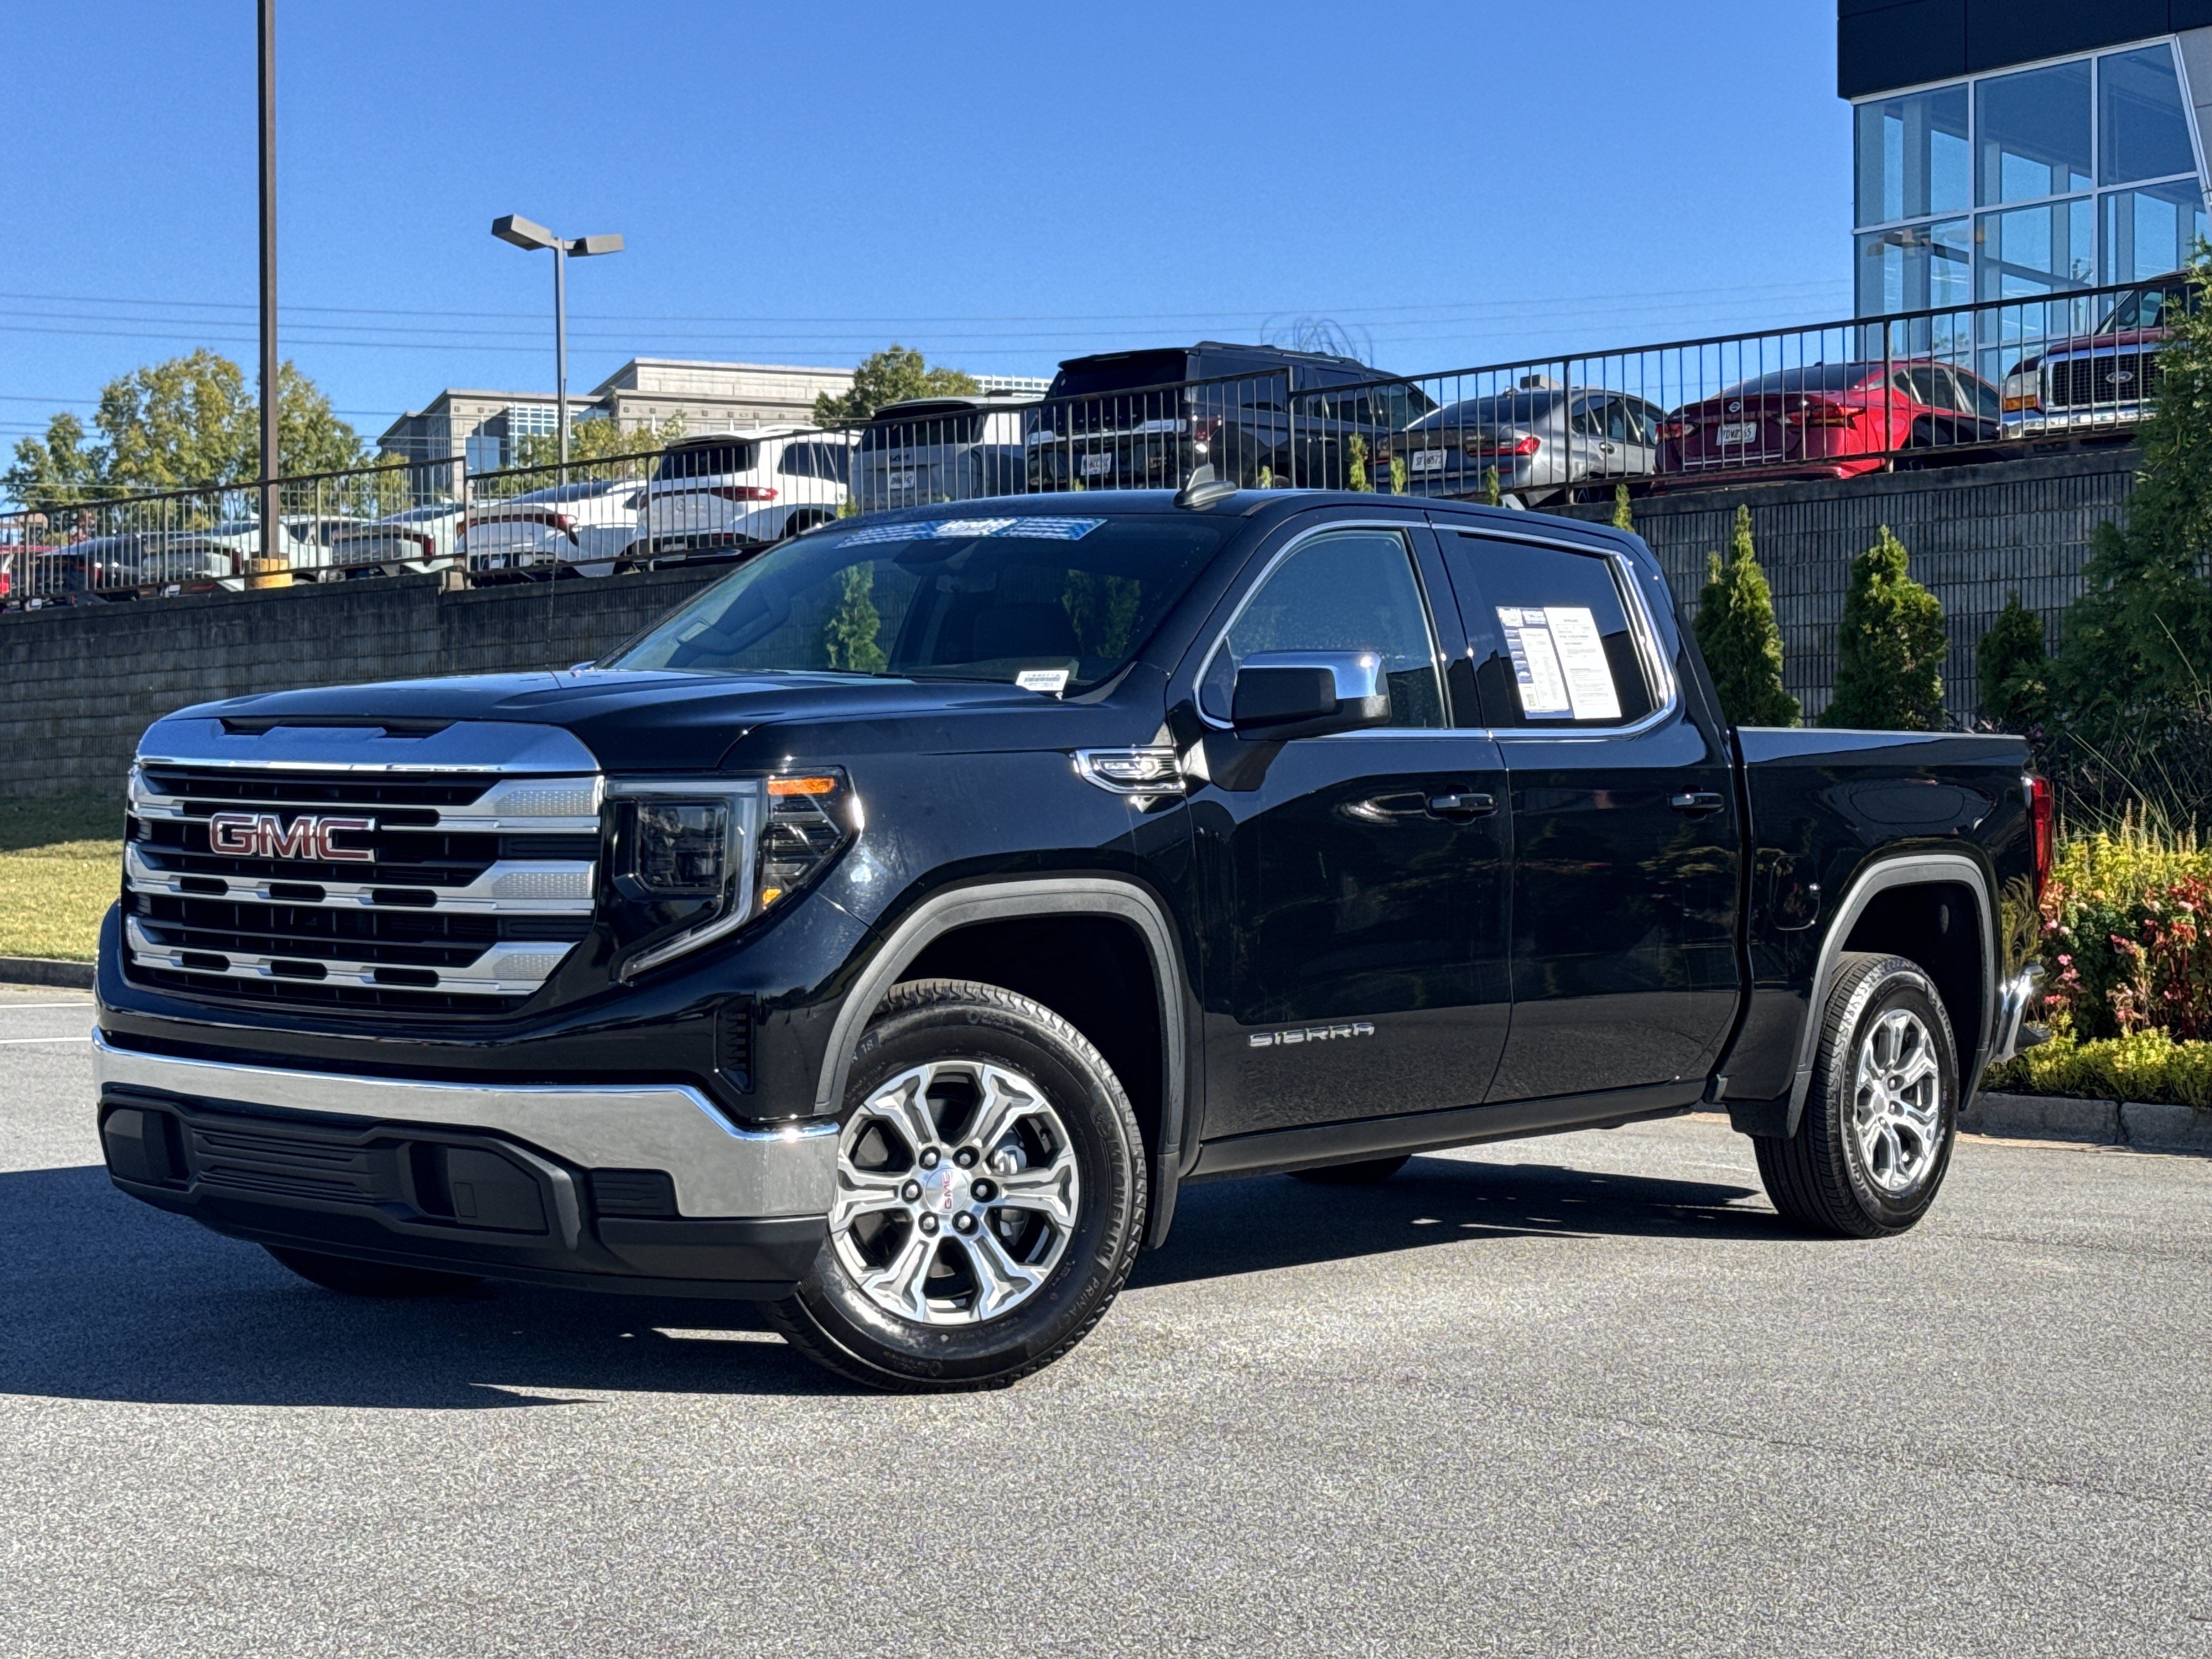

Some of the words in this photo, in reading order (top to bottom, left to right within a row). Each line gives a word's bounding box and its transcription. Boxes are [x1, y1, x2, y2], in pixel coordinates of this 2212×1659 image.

[210, 811, 376, 863] GMC
[1248, 1022, 1375, 1047] SIERRA
[941, 1171, 953, 1210] GMC
[1099, 1139, 1126, 1261] MICHELIN
[1057, 1277, 1101, 1331] PRIMACY
